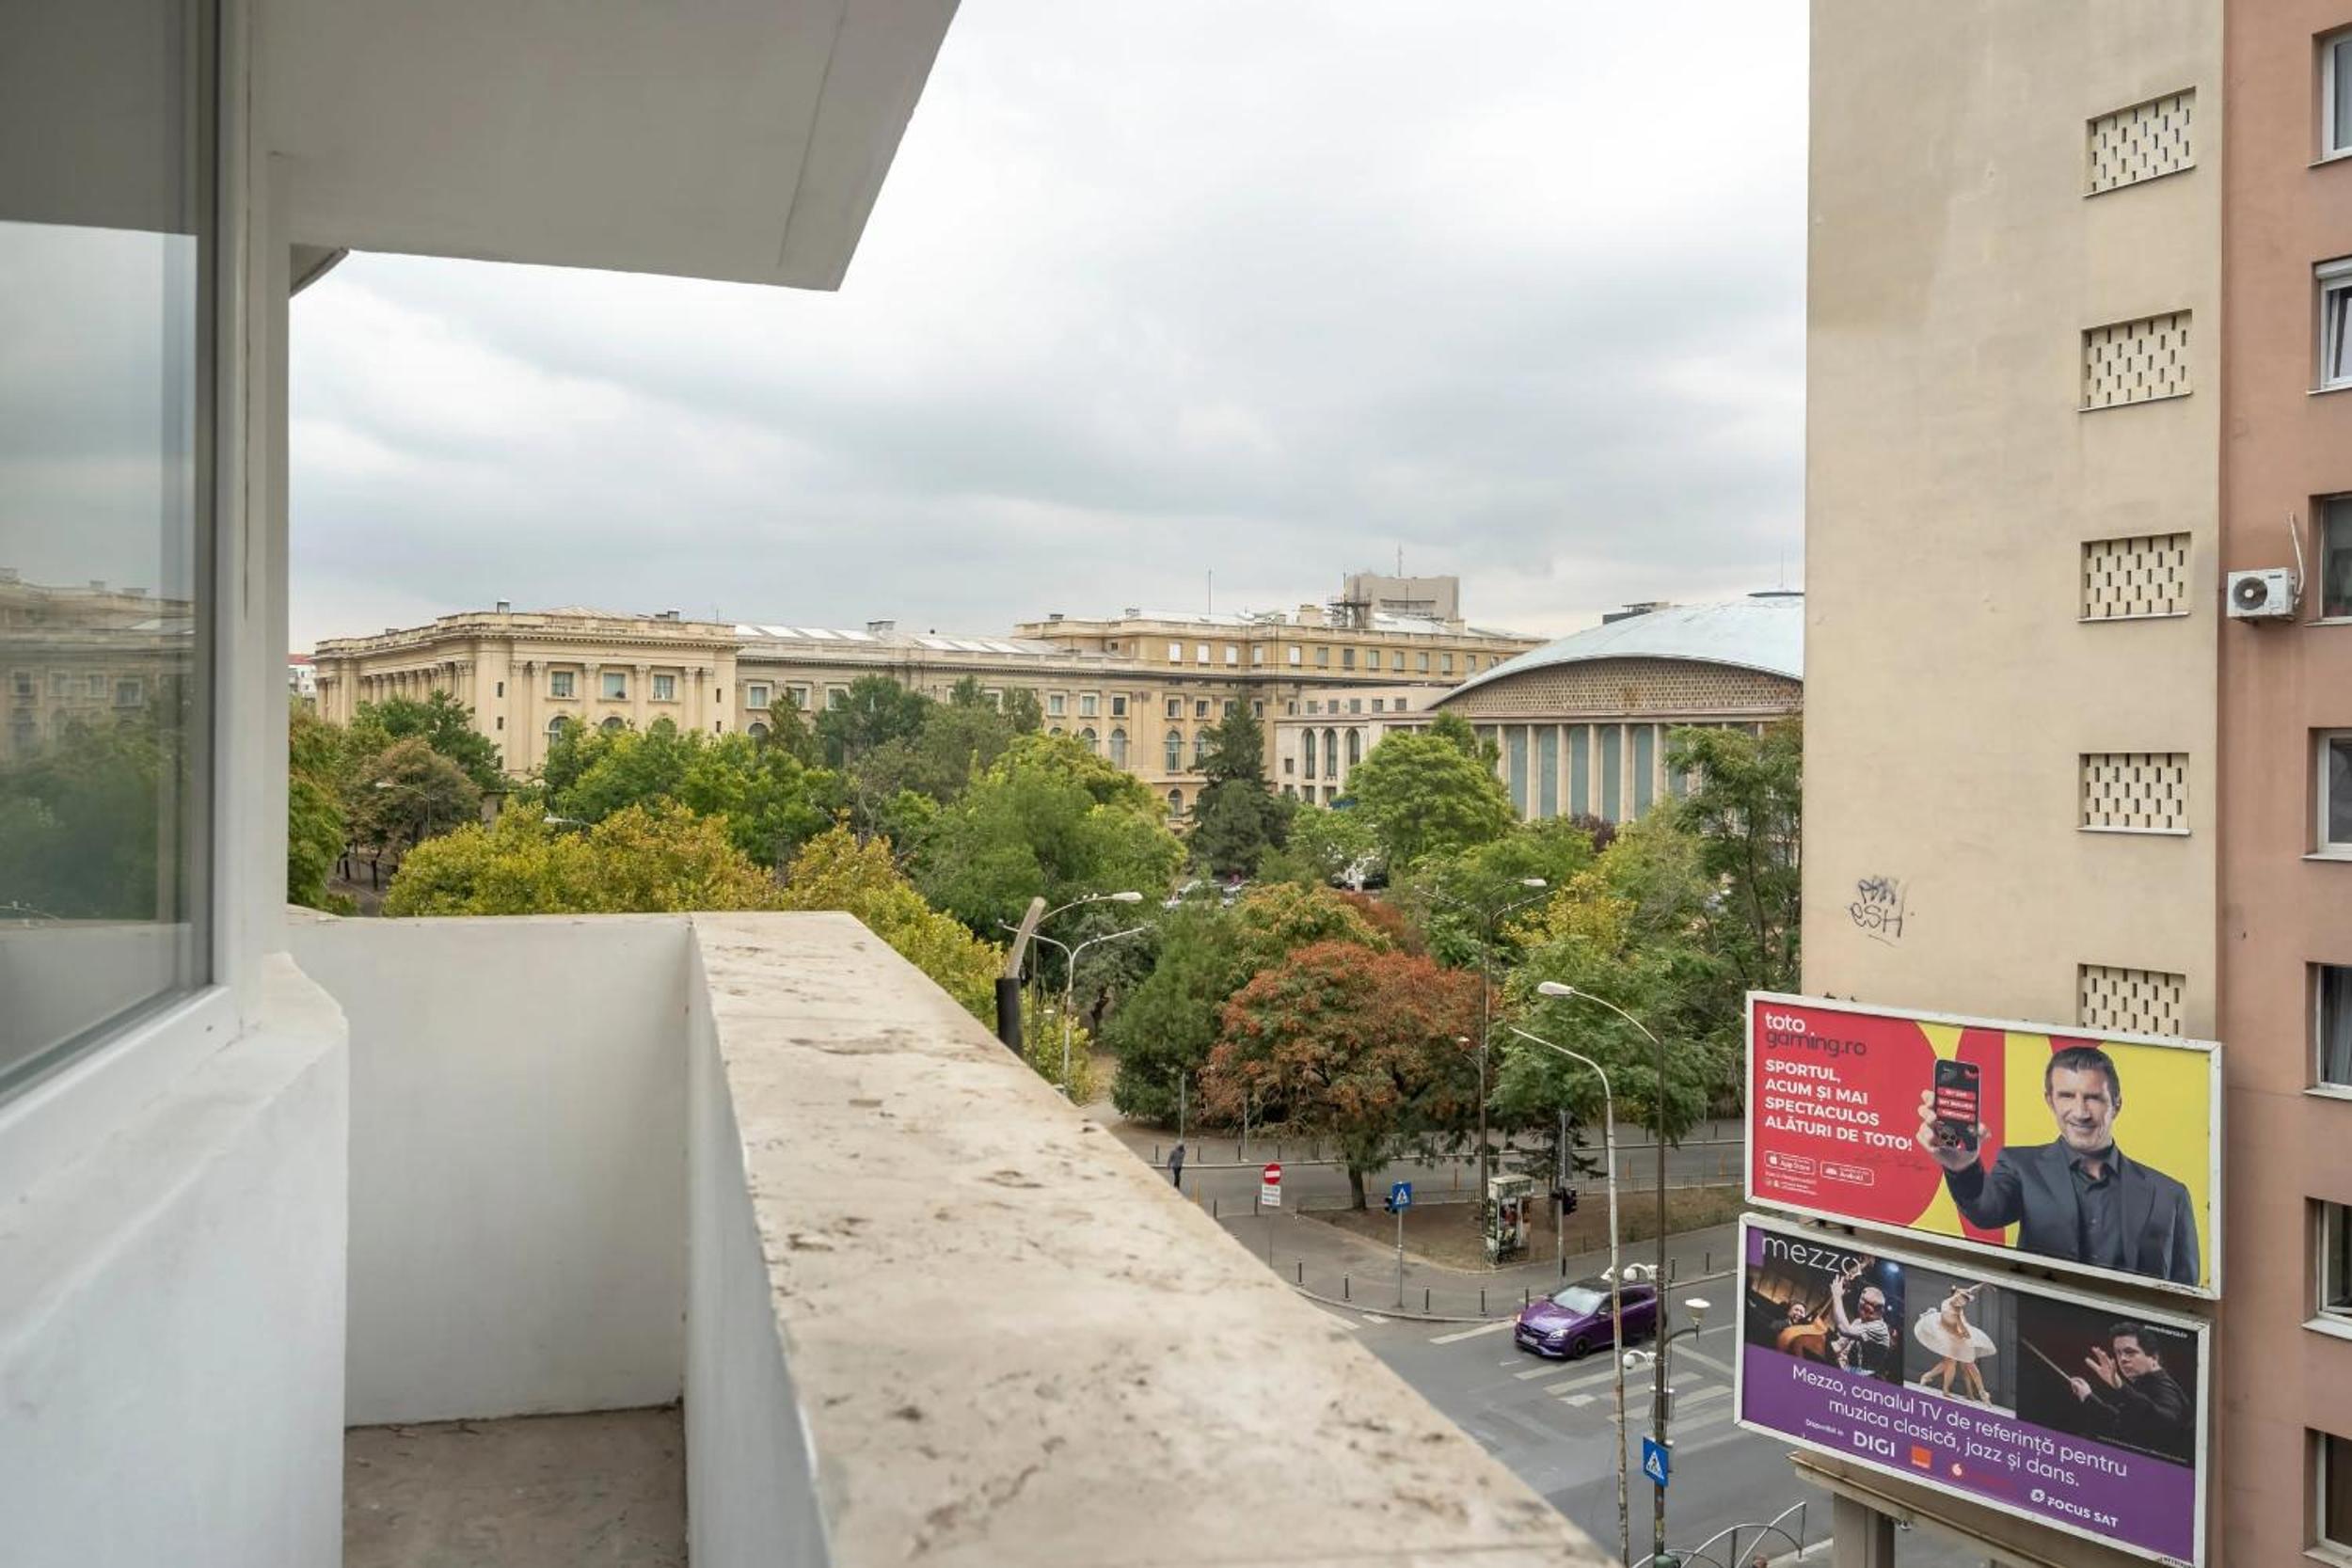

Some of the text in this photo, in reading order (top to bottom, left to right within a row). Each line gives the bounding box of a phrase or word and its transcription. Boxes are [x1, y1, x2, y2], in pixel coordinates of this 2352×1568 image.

[1765, 1012, 1805, 1033] toto
[1767, 1031, 1867, 1057] gaming.ro
[1765, 1059, 1841, 1083] SPORTUL,
[1765, 1079, 1811, 1097] ACUM
[1836, 1088, 1867, 1105] MAI
[1765, 1097, 1880, 1126] SPECTACULOS
[1765, 1116, 1913, 1152] ALĂTURI DE TOTO!
[1761, 1237, 1862, 1279] mezzo
[1793, 1364, 1847, 1396] Mezzo,
[1851, 1386, 1914, 1414] canalul
[1919, 1401, 1942, 1420] TV
[1947, 1411, 1970, 1430] de
[1976, 1421, 2054, 1456] referință
[2059, 1446, 2127, 1477] pentru
[1829, 1400, 1888, 1428] muzica
[1894, 1418, 1961, 1452] clasică,
[1964, 1437, 2002, 1462] jazz
[2026, 1458, 2079, 1486] dans.
[1853, 1431, 1895, 1457] DIGI
[2046, 1496, 2119, 1528] FOCUS SAT
